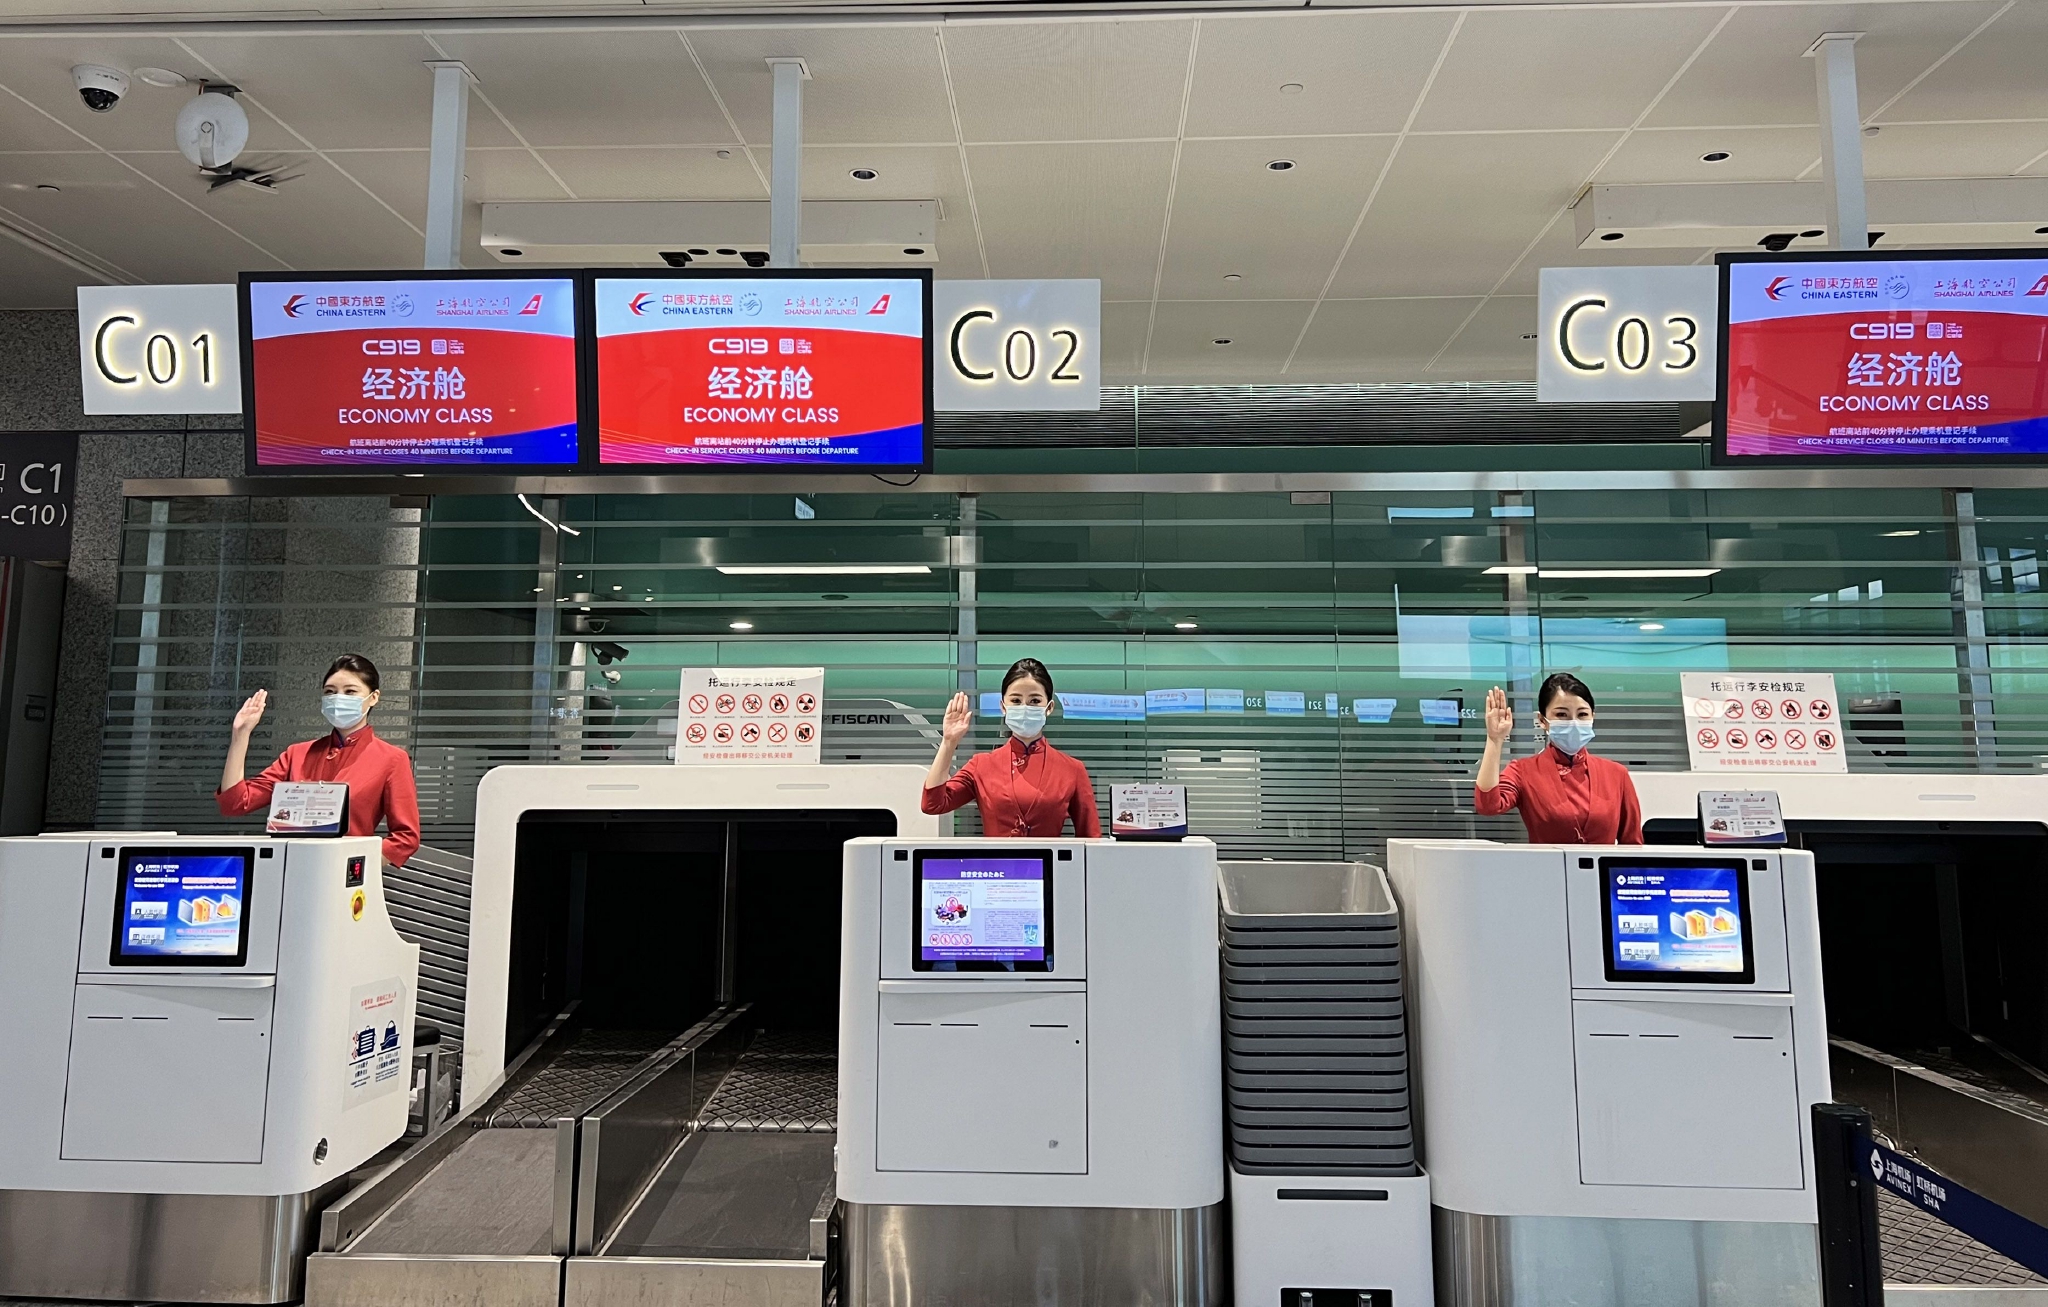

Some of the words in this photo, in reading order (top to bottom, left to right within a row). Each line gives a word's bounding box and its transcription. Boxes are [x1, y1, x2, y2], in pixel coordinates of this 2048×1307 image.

[1801, 277, 1879, 290] 中國東方航空
[316, 295, 386, 307] 中國東方航空
[662, 294, 734, 306] 中國東方航空
[1801, 290, 1832, 299] CHINA
[1833, 290, 1878, 299] EASTERN
[1934, 290, 1975, 298] SHANGHAI
[316, 309, 343, 317] CHINA
[345, 308, 386, 317] EASTERN
[662, 307, 690, 316] CHINA
[692, 307, 733, 316] EASTERN
[784, 308, 822, 316] SHANGHAI
[824, 308, 857, 316] AIRLINES
[1560, 299, 1697, 371] C03
[1850, 322, 1915, 340] C919
[95, 315, 210, 384] C01
[362, 339, 421, 356] C919
[708, 338, 769, 355] C919
[950, 310, 1079, 380] C02
[1847, 350, 1962, 387] 经济舱
[361, 366, 466, 400] 经济舱
[707, 365, 813, 399] 经济舱
[1819, 395, 1921, 412] ECONOMY
[1926, 394, 1989, 411] CLASS
[338, 408, 430, 424] ECONOMY
[435, 407, 493, 424] CLASS
[683, 407, 777, 423] ECONOMY
[781, 407, 839, 423] CLASS
[355, 448, 381, 456] SERVICE
[475, 447, 513, 455] DEPARTURE
[700, 447, 727, 455] SERVICE
[728, 447, 755, 455] CLOSES
[755, 447, 765, 455] 40
[766, 447, 794, 455] MINUTES
[796, 447, 820, 455] BEFORE
[821, 447, 859, 455] DEPARTURE
[20, 462, 62, 494] C1
[1711, 681, 1806, 692] 托运行李安检规定
[831, 714, 891, 725] FISCAN
[1886, 1173, 1913, 1196] AVINEX
[1923, 1193, 1941, 1212] SHA
